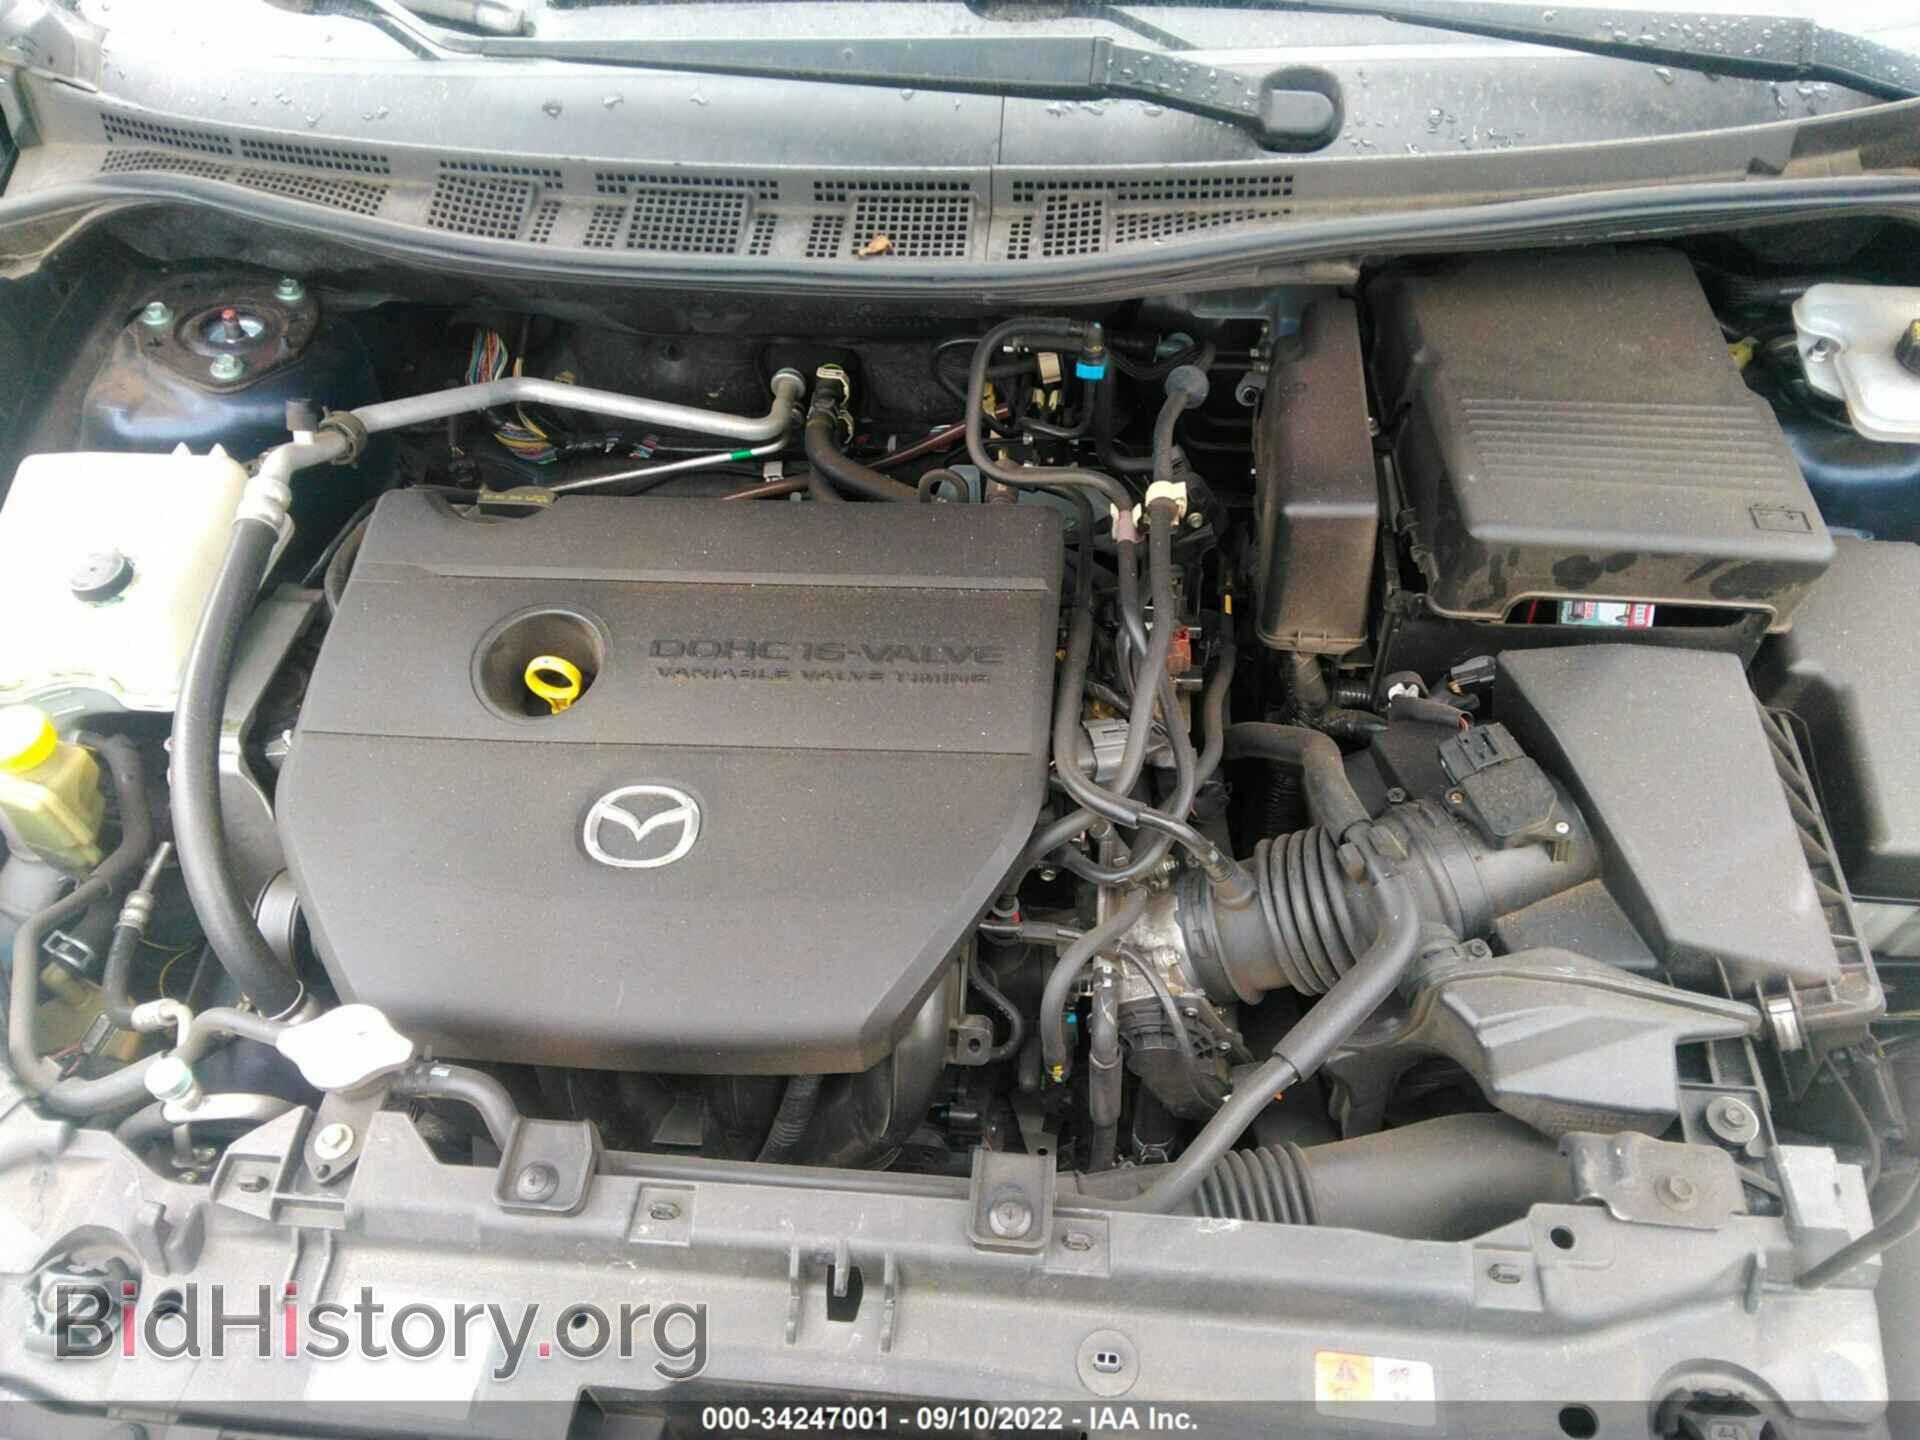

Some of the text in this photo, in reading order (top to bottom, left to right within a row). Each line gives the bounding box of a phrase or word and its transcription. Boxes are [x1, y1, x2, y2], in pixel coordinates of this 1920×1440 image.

[649, 639, 1006, 666] DOHC 16-VALVE
[656, 667, 793, 682] VARIABLE
[800, 669, 886, 683] VALVE
